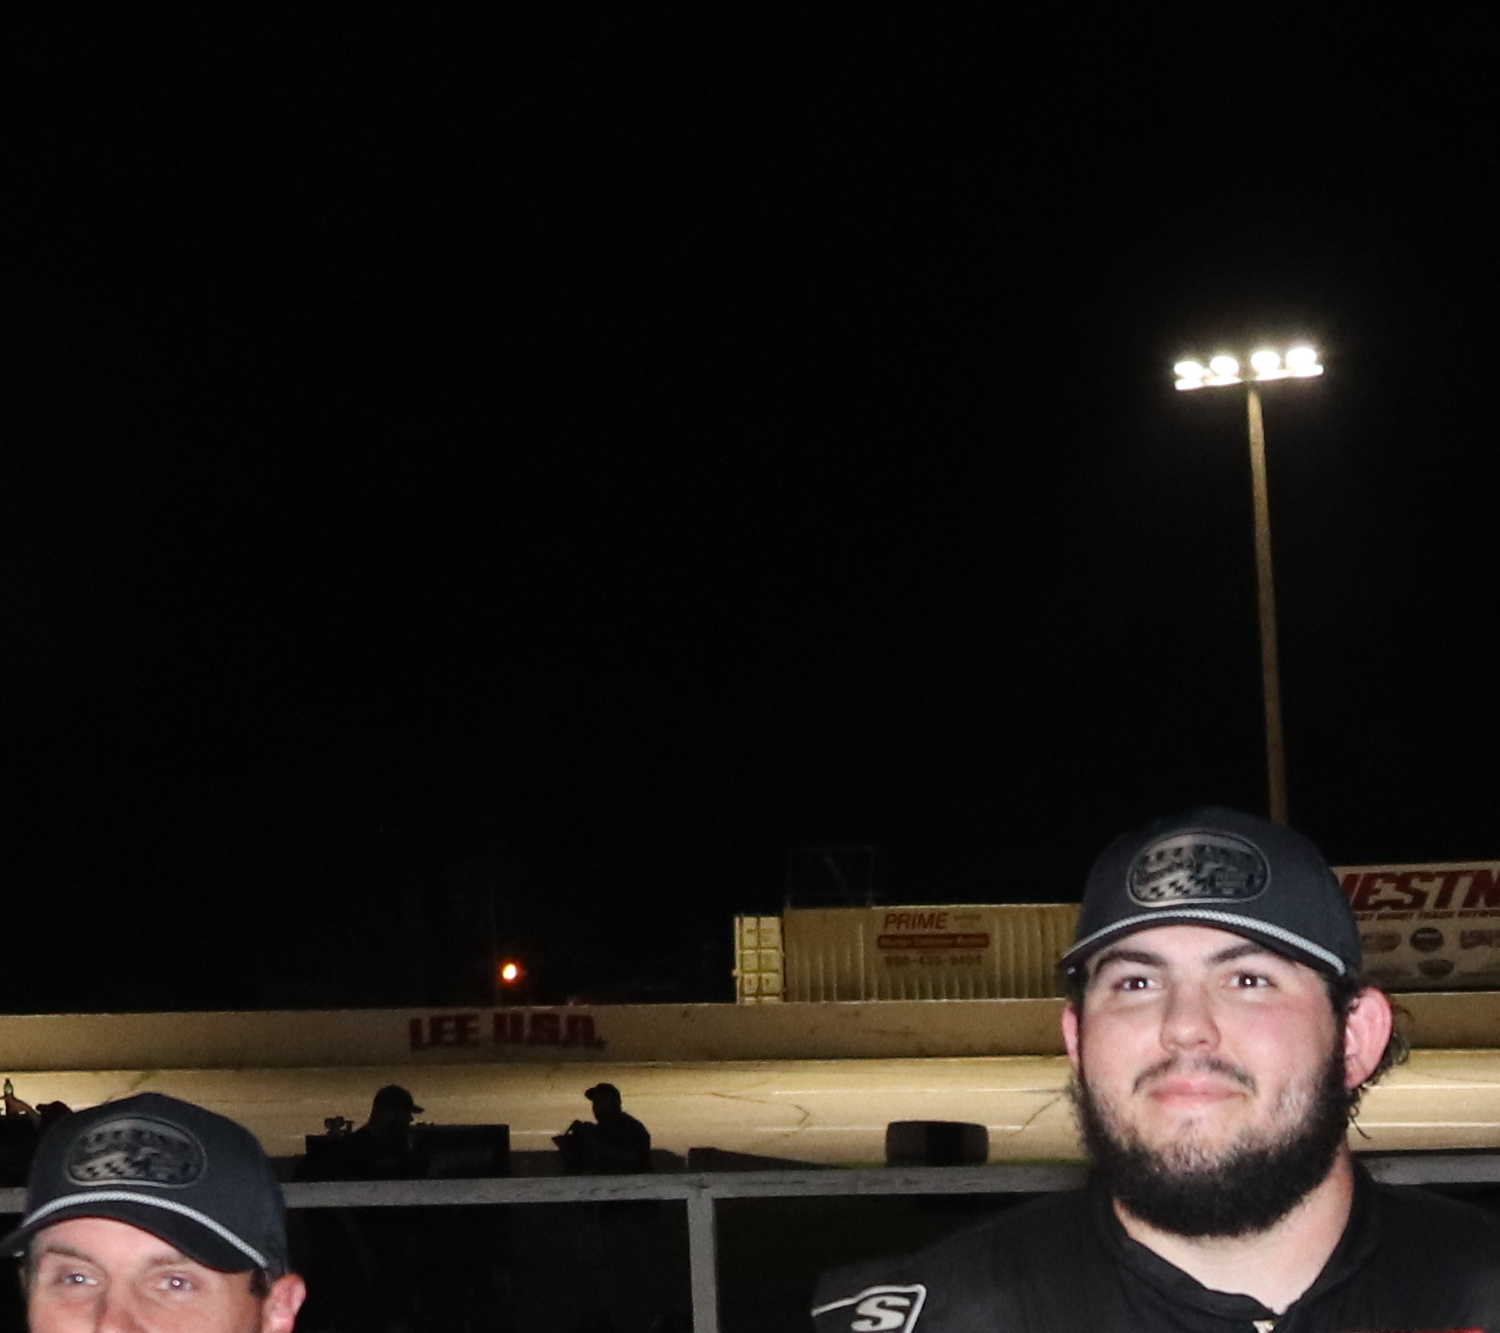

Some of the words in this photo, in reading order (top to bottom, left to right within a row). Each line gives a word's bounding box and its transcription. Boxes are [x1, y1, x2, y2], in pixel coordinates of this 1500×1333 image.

[884, 912, 950, 930] PRIME
[409, 1013, 479, 1050] LEE
[493, 1011, 604, 1050] USA
